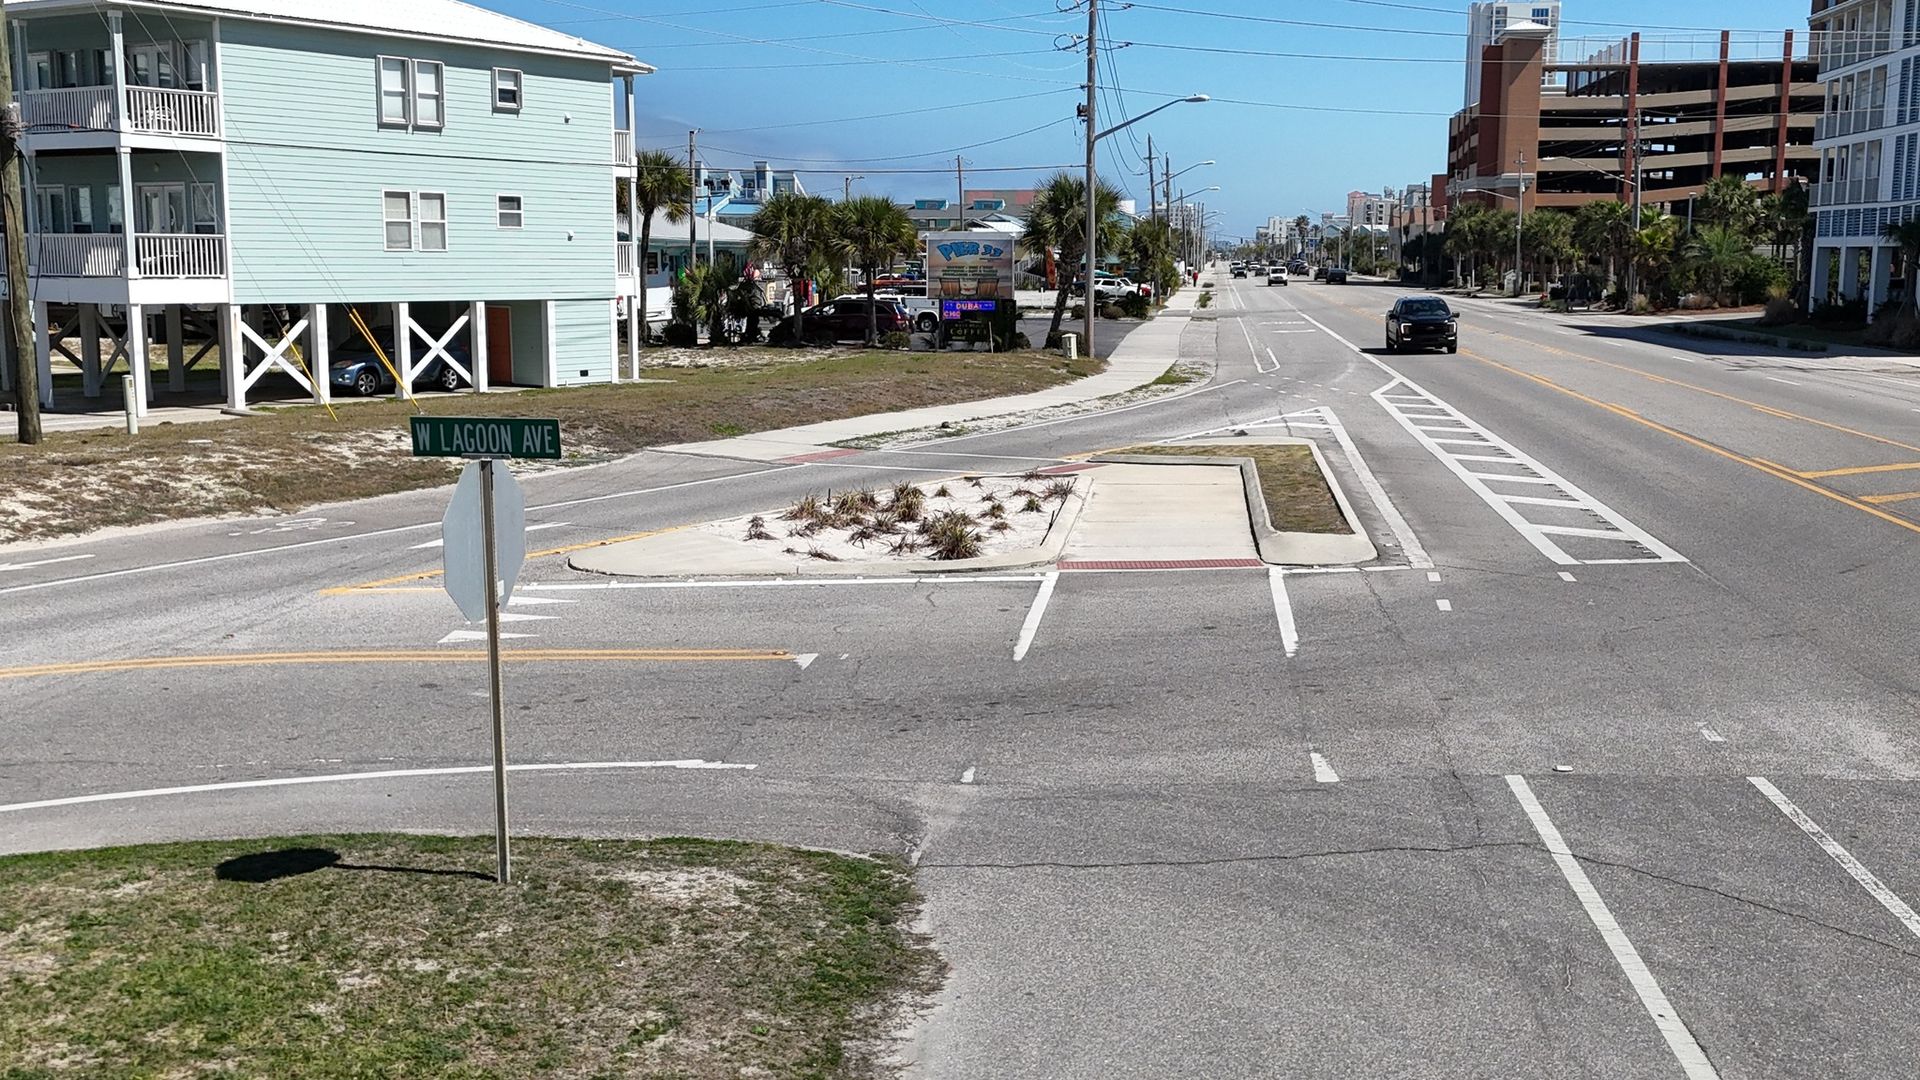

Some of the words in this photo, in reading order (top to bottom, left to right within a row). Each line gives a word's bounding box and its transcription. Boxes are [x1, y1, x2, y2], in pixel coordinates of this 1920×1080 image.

[937, 241, 980, 261] PIER
[415, 423, 430, 451] W
[439, 423, 512, 453] LAGOON
[522, 425, 555, 454] AVE
